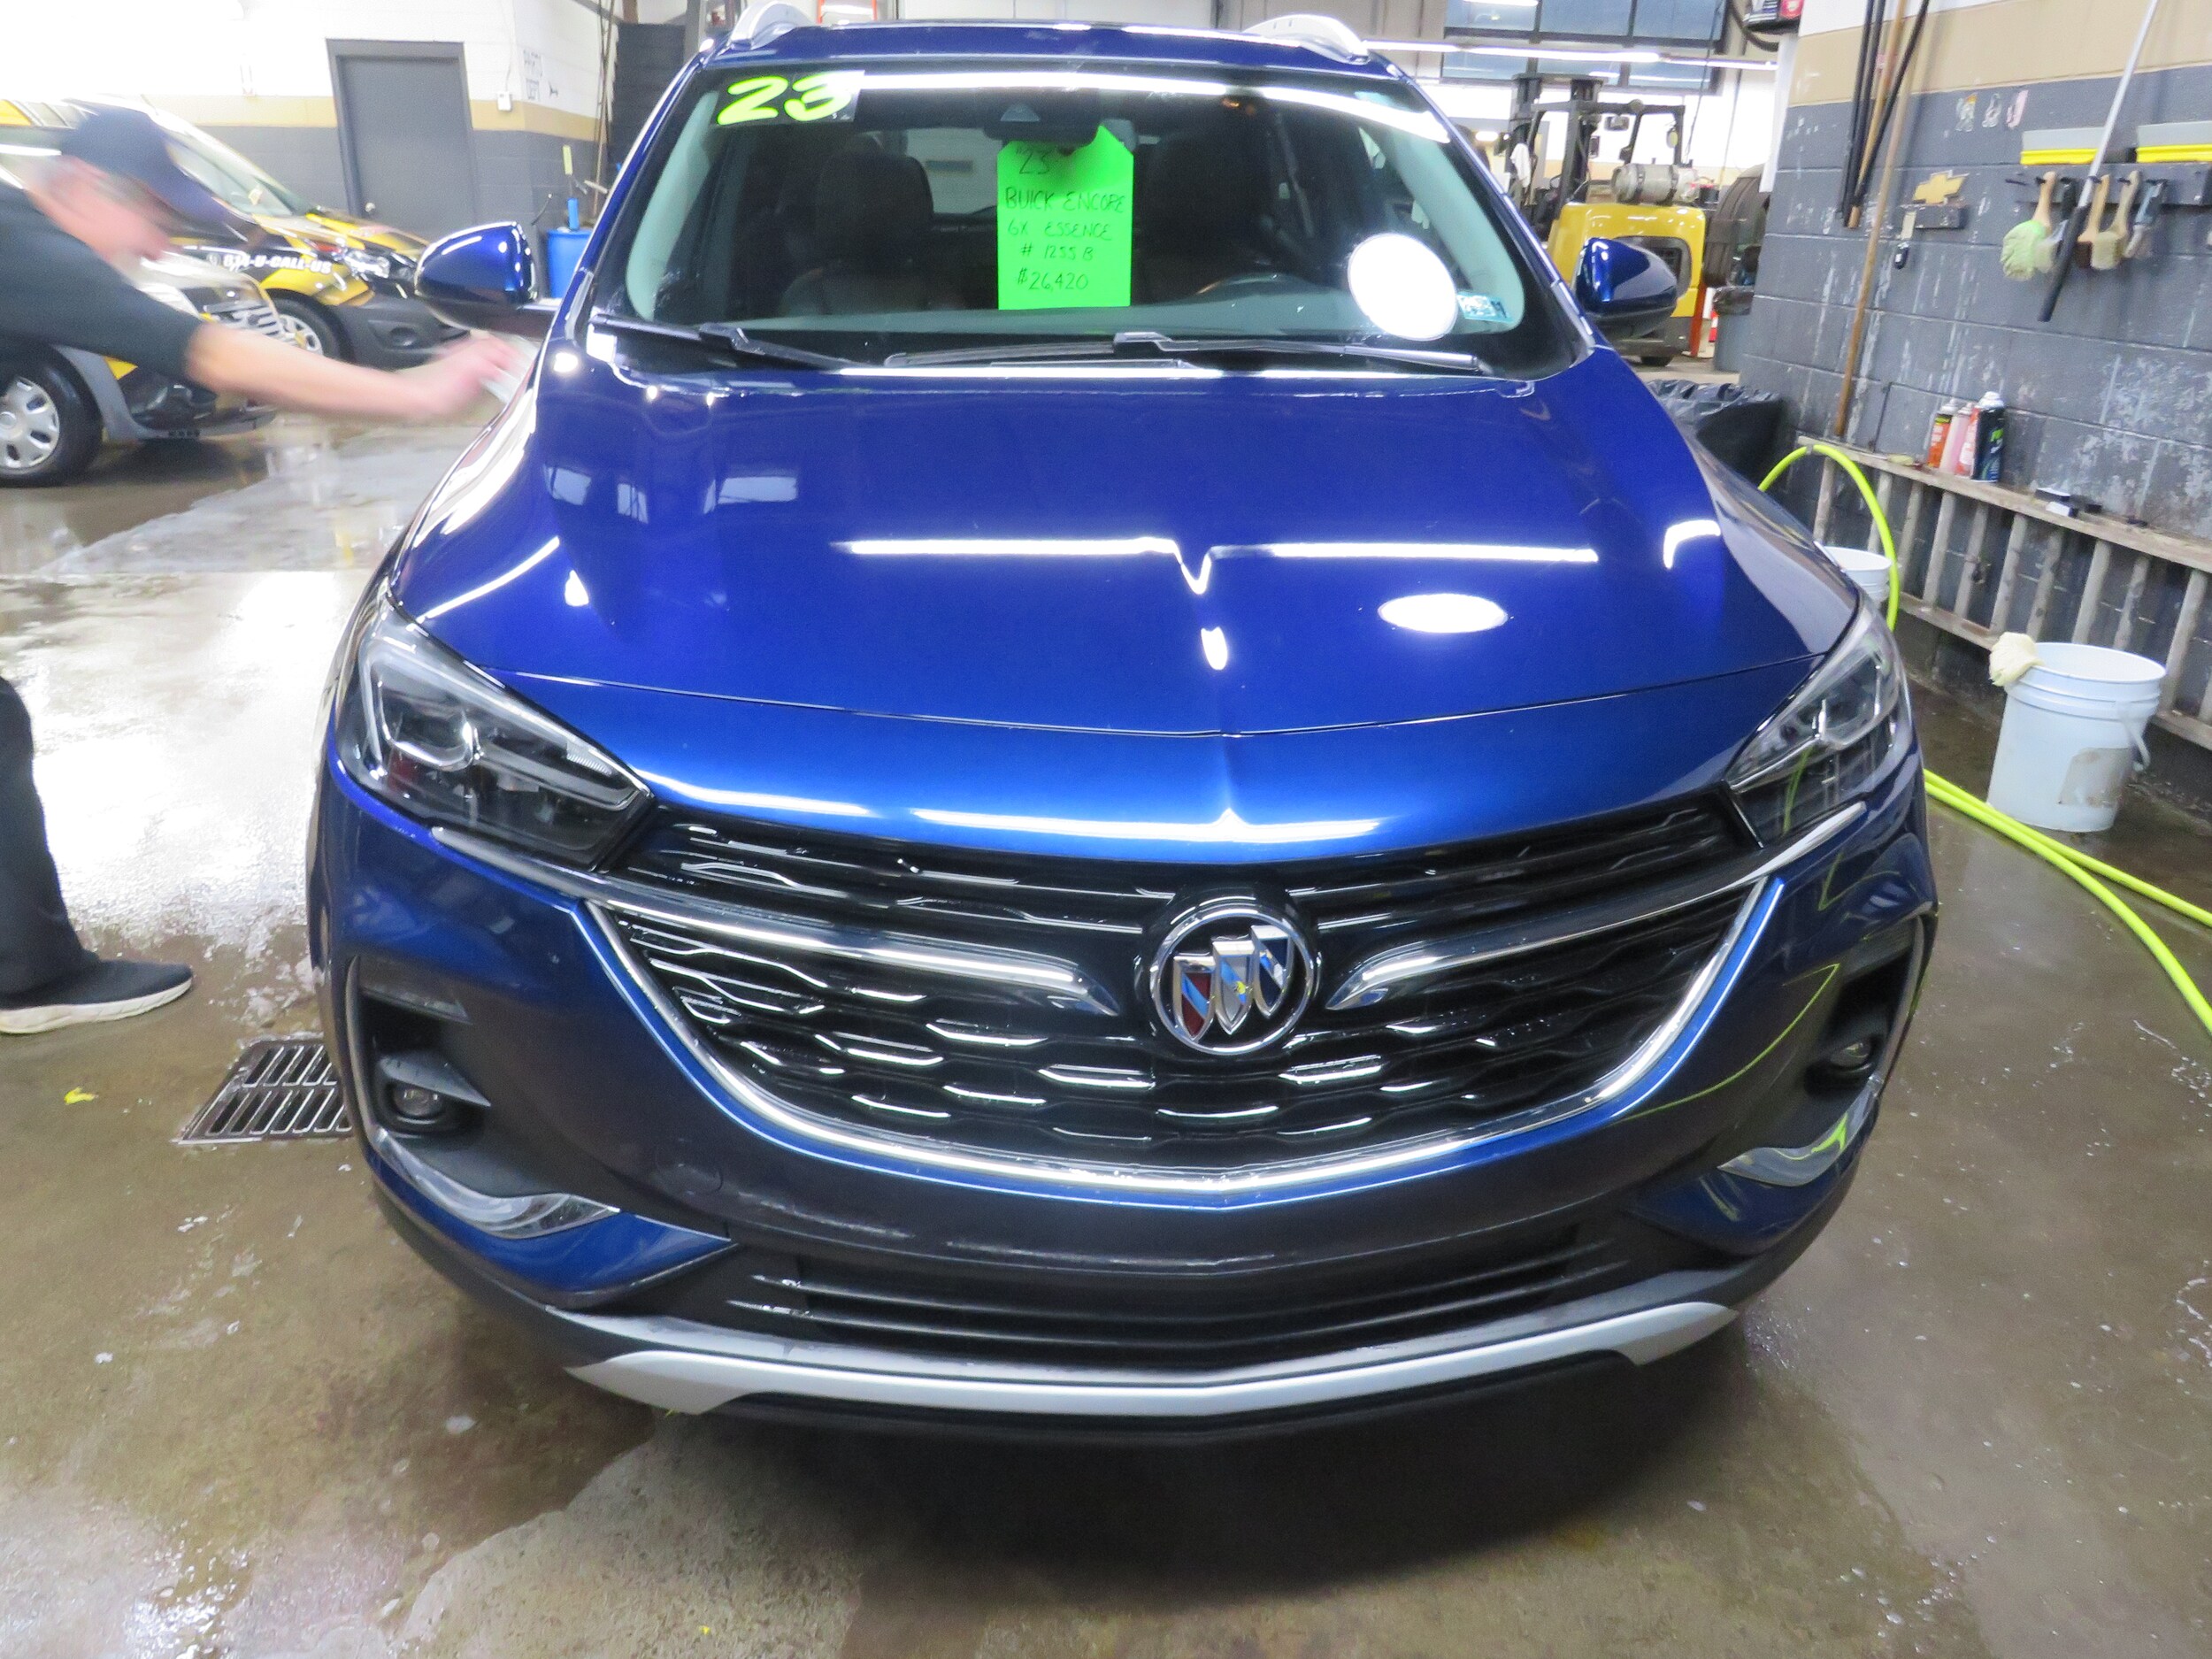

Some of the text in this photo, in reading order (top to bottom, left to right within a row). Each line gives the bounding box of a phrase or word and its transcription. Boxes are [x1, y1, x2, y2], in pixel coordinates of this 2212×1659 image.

[717, 70, 864, 126] 23
[1005, 186, 1055, 211] BUICK
[1044, 221, 1112, 241] ESSENCE
